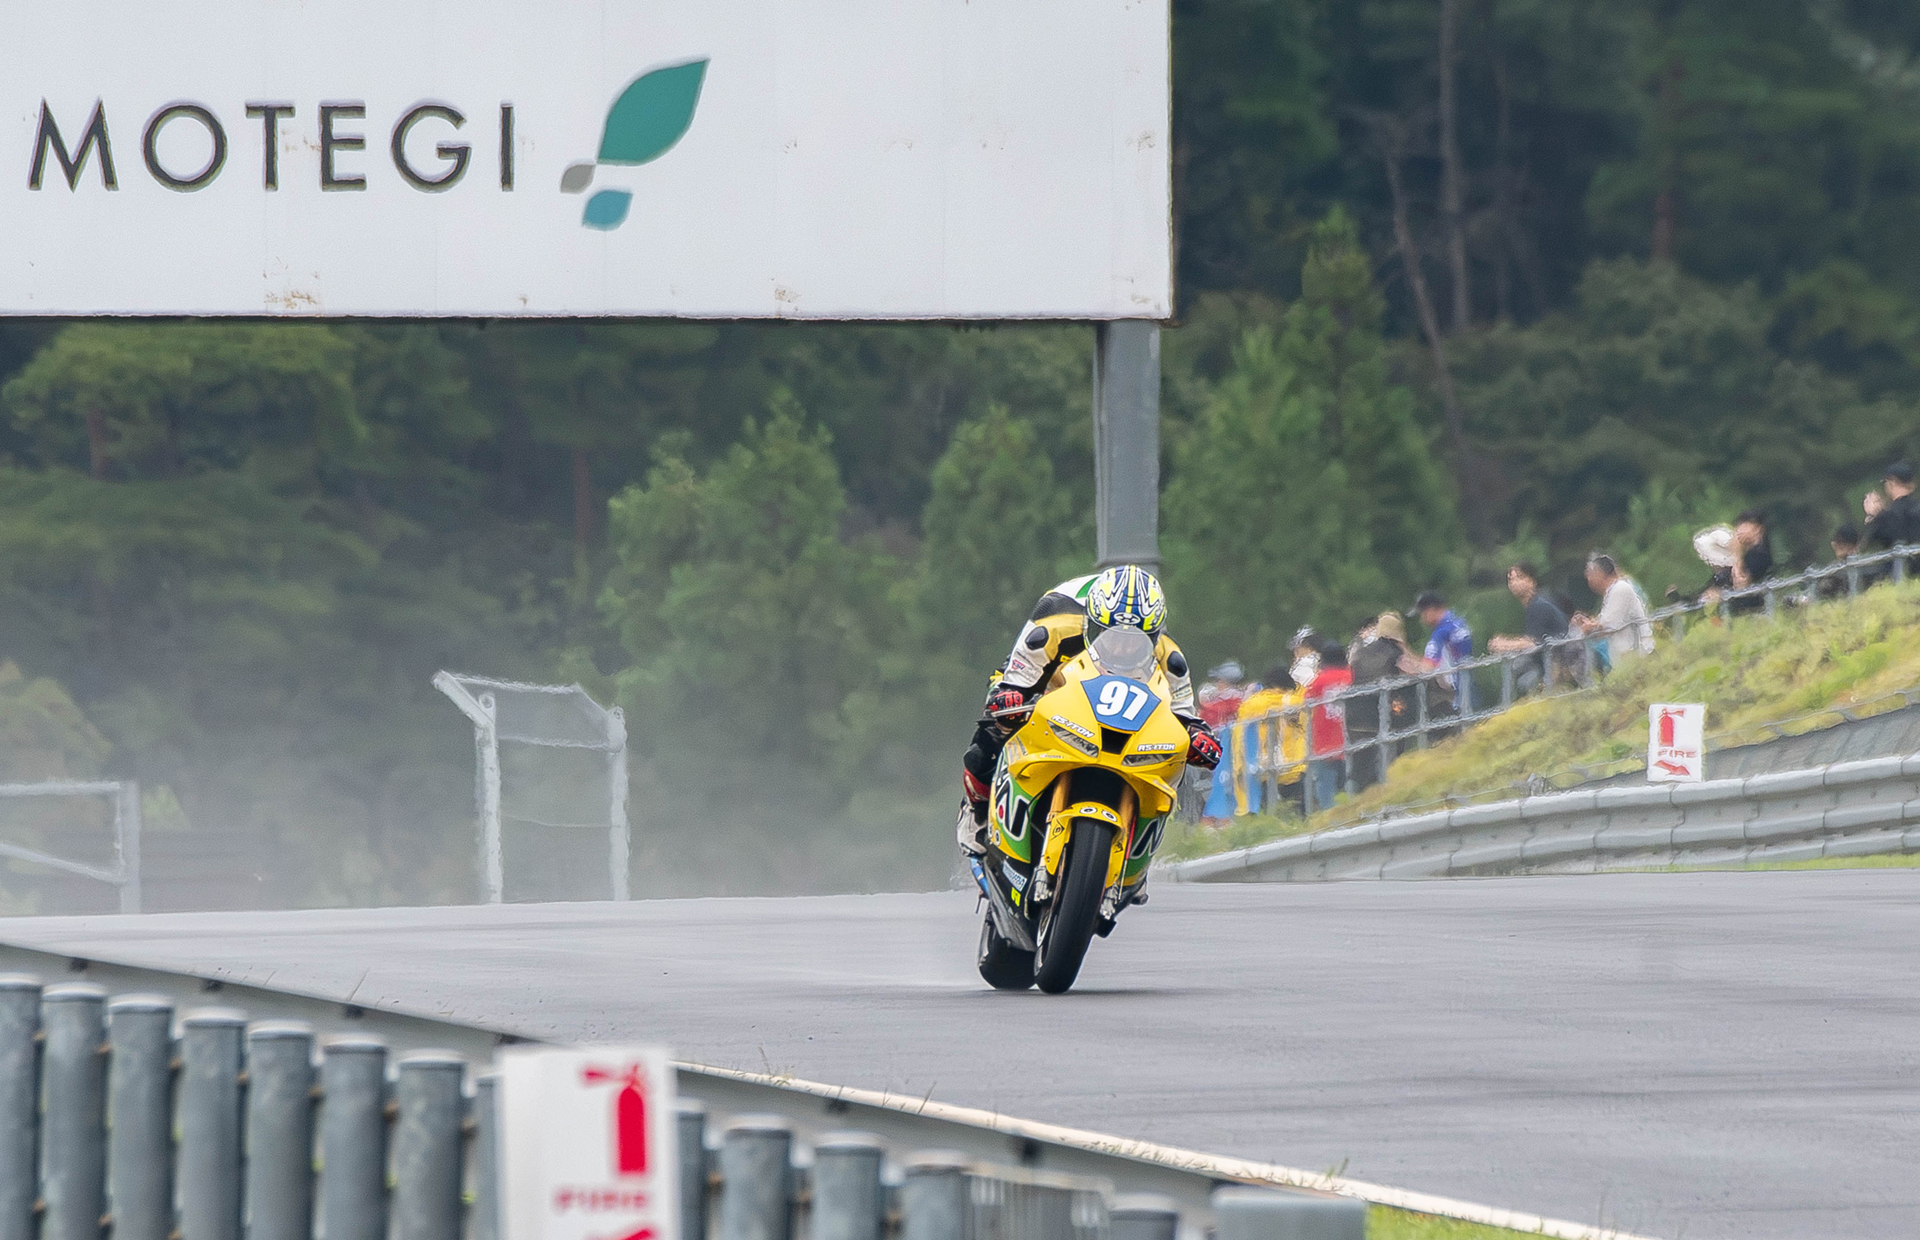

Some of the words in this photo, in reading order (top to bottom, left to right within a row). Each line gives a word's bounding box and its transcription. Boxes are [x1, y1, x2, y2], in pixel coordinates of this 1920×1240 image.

[27, 97, 515, 193] MOTEGI
[1096, 680, 1149, 721] 97
[1657, 749, 1698, 758] FIRE
